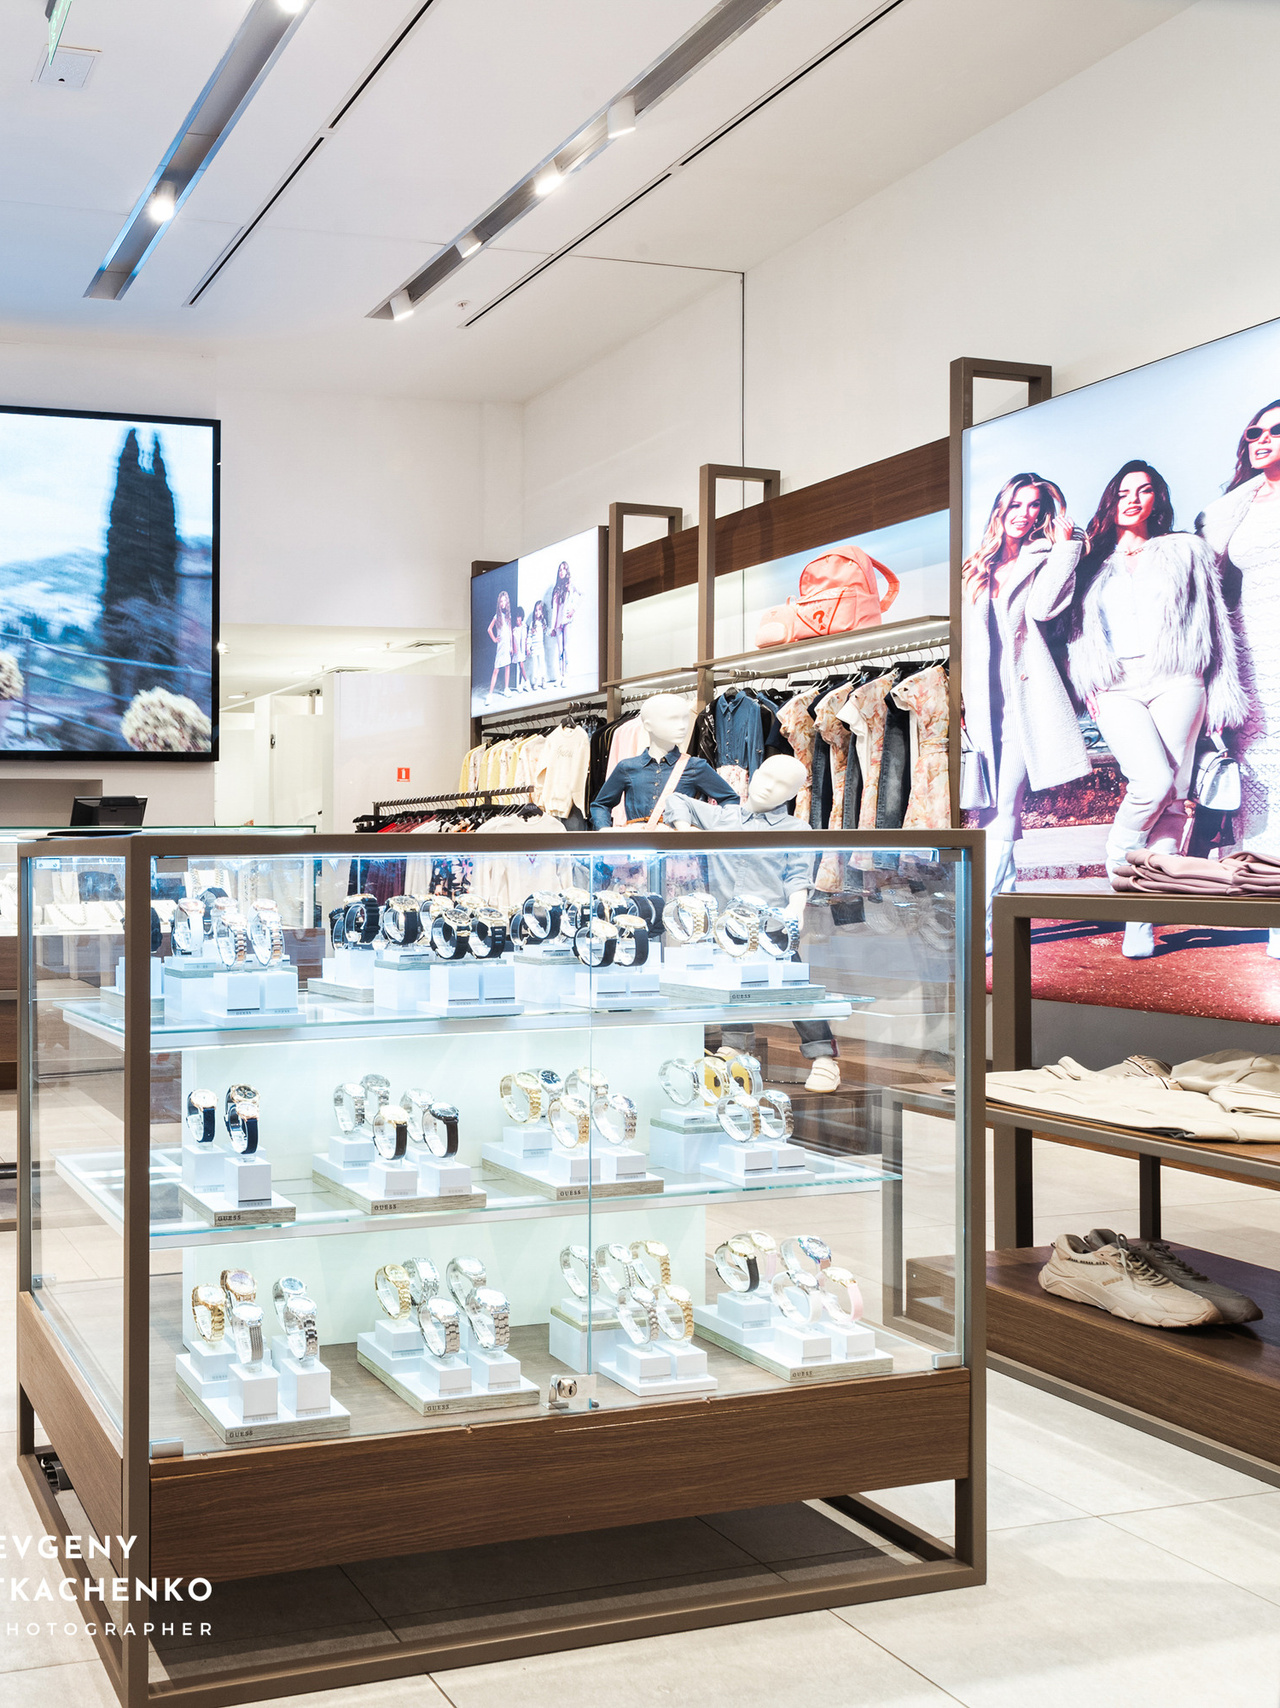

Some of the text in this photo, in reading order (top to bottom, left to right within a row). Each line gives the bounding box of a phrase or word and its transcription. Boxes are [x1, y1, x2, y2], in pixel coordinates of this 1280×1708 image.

[559, 1189, 581, 1197] GUESS
[374, 1203, 397, 1211] GUESS
[217, 1214, 241, 1222] GUESS
[792, 1370, 813, 1378] GUESS
[426, 1403, 450, 1411] GUESS
[229, 1430, 254, 1438] GUESS
